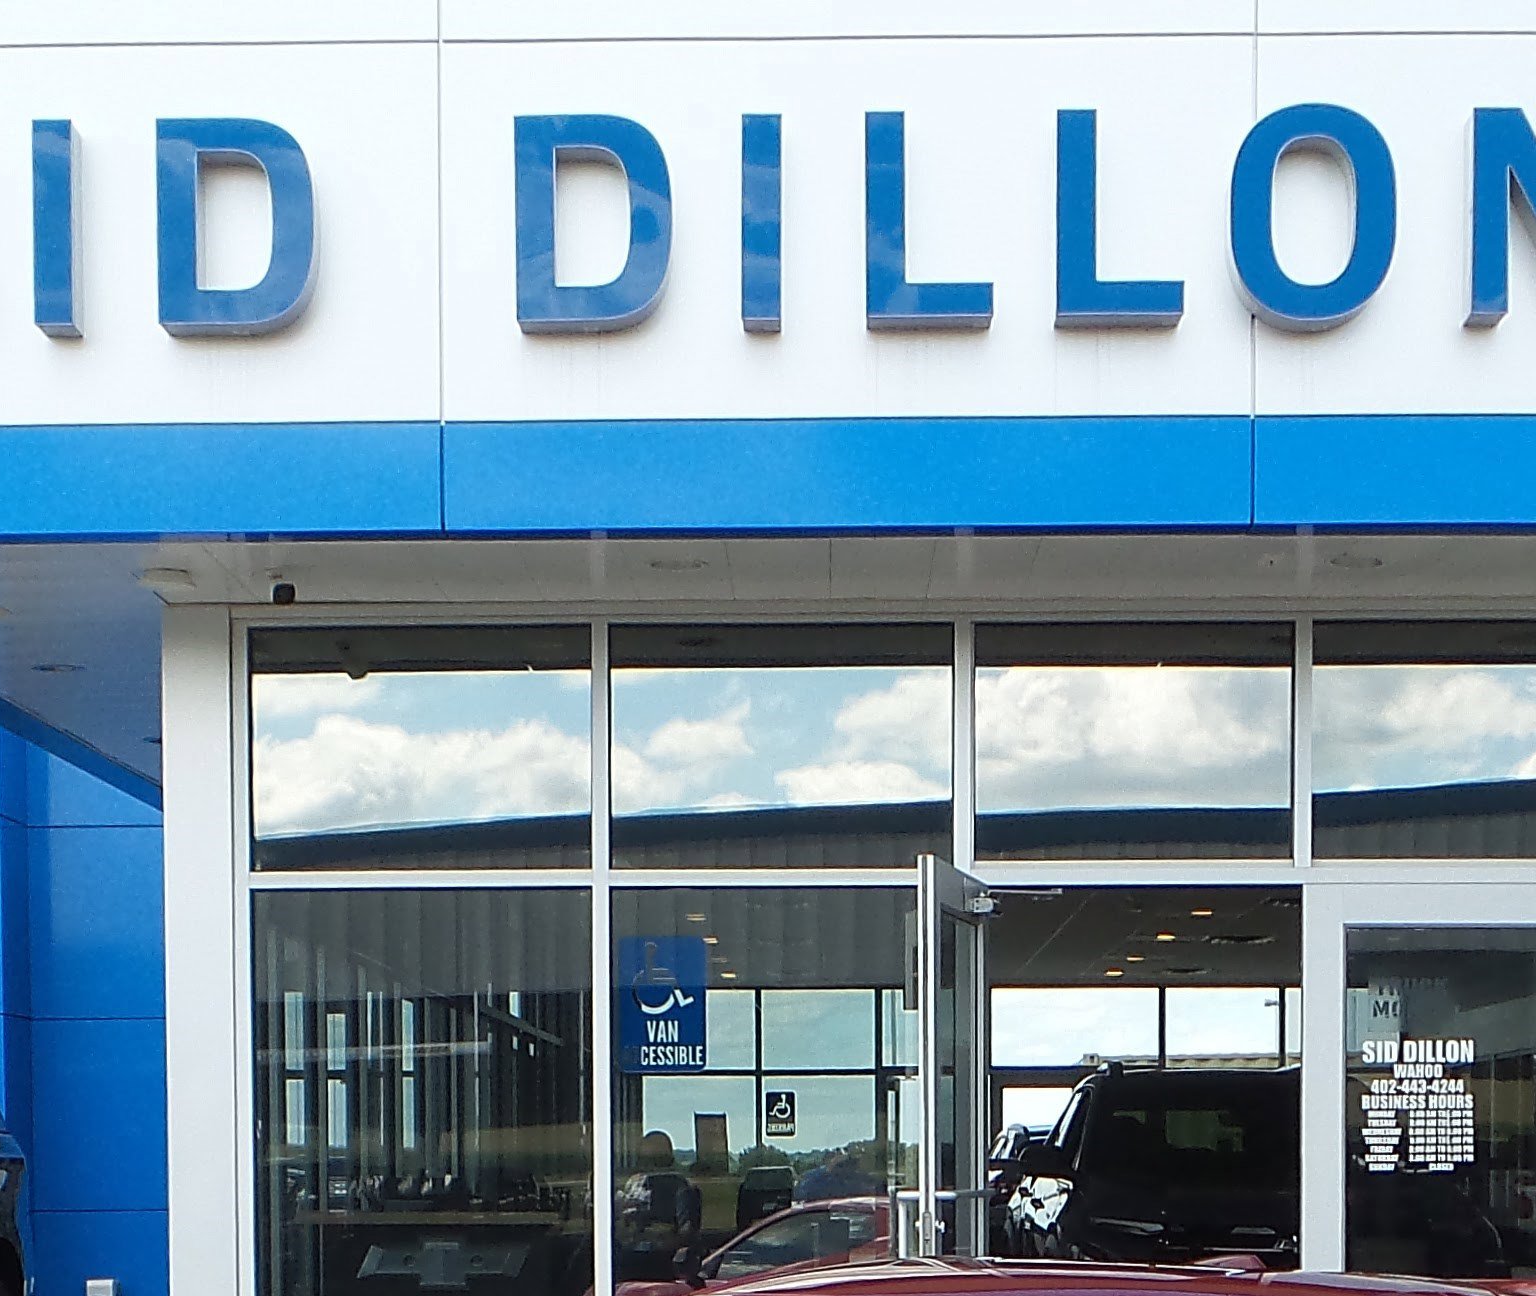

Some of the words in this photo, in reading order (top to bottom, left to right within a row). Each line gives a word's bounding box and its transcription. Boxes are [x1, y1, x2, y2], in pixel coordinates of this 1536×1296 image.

[646, 1019, 679, 1043] VAN
[631, 1045, 705, 1066] CESSIBLE
[1362, 1040, 1397, 1063] SID
[1403, 1039, 1474, 1063] DILLON
[1393, 1064, 1443, 1078] WAHOO
[1370, 1079, 1464, 1094] 402-443-4244
[1361, 1094, 1426, 1109] BUSINESS
[1428, 1094, 1474, 1109] HOURS
